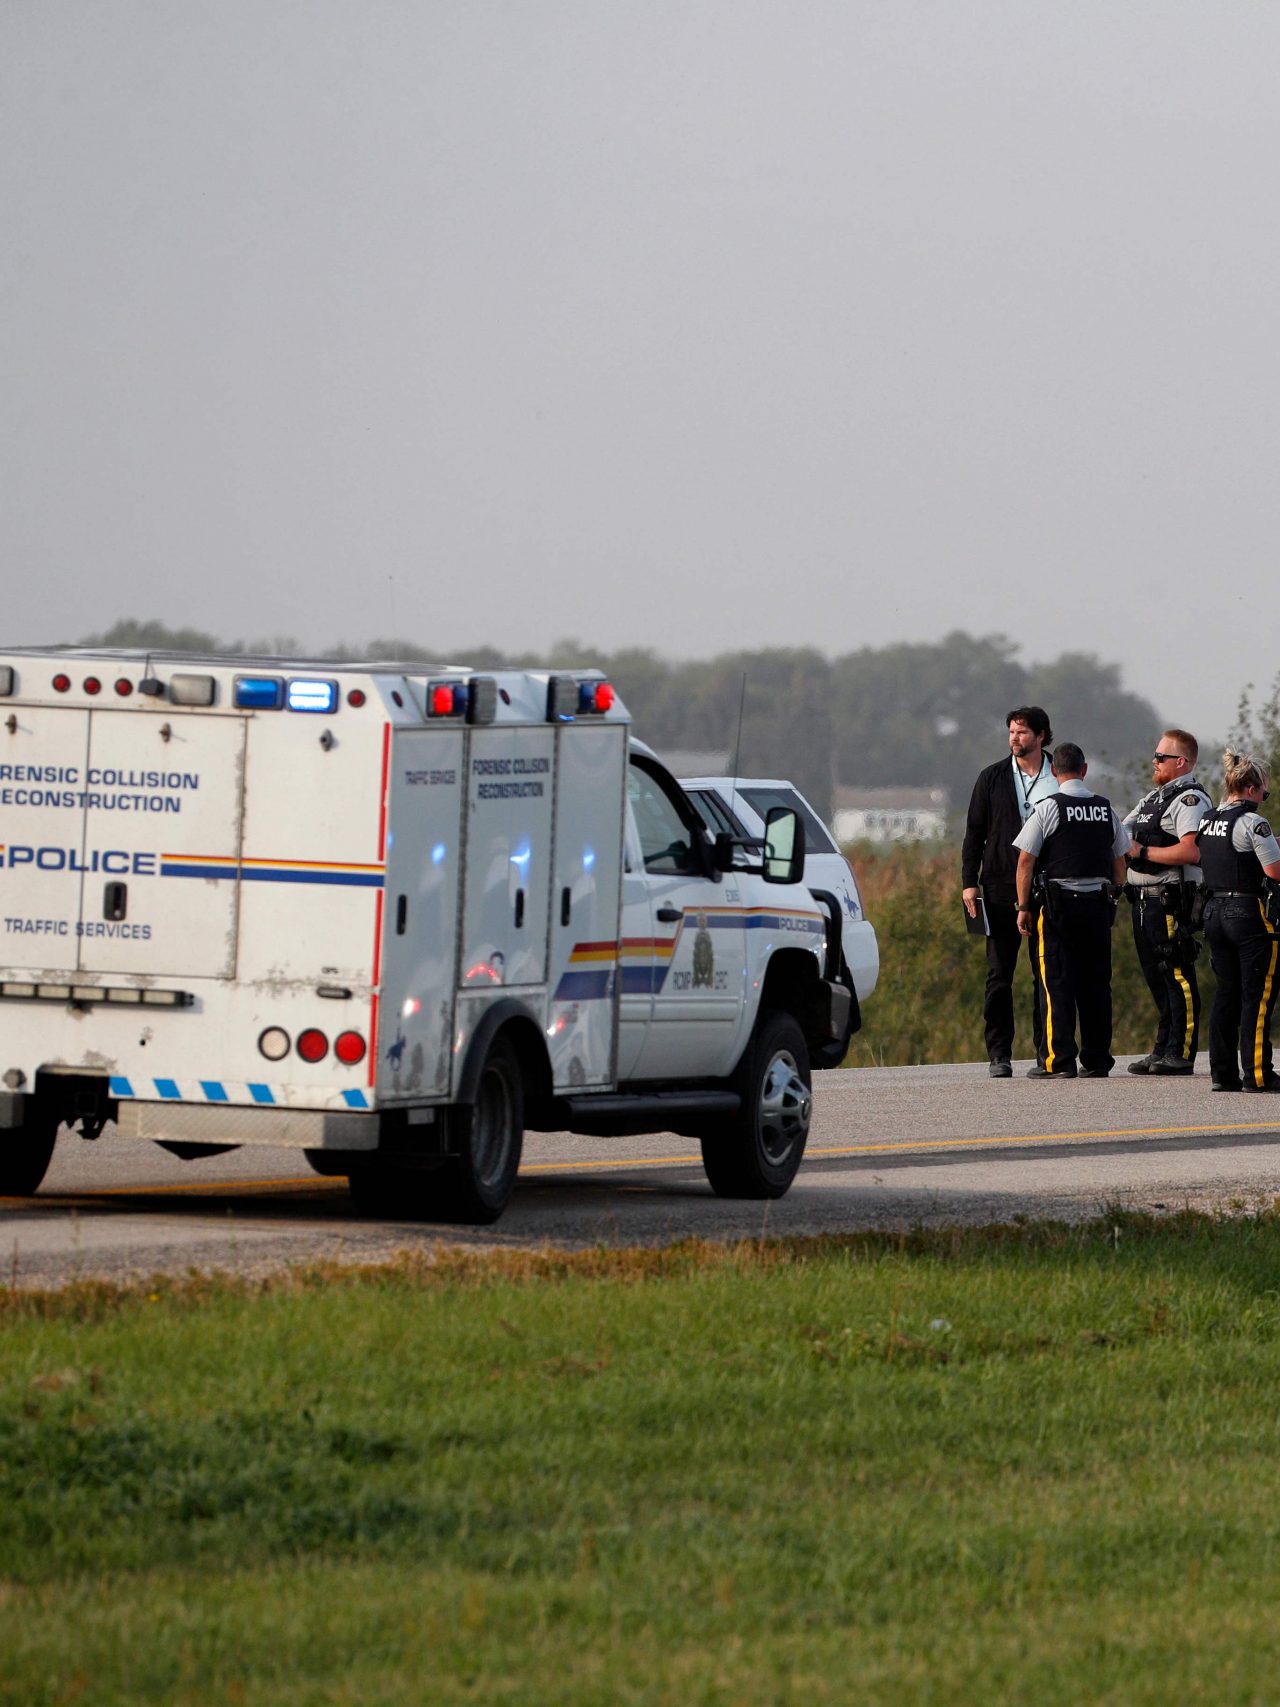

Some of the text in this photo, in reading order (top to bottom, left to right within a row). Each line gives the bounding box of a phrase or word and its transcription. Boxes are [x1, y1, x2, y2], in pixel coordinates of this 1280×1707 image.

[472, 757, 550, 775] FORENSIC COLLISION
[0, 764, 200, 790] RENSIC COLLISION
[477, 781, 544, 800] RECONSTRUCTION
[0, 788, 182, 813] ECONSTRUCTION
[1066, 806, 1109, 822] POLICE
[1199, 818, 1229, 837] POLICE
[8, 846, 157, 876] POLICE
[4, 918, 153, 940] TRAFFIC SERVICES
[780, 917, 809, 932] POLICE
